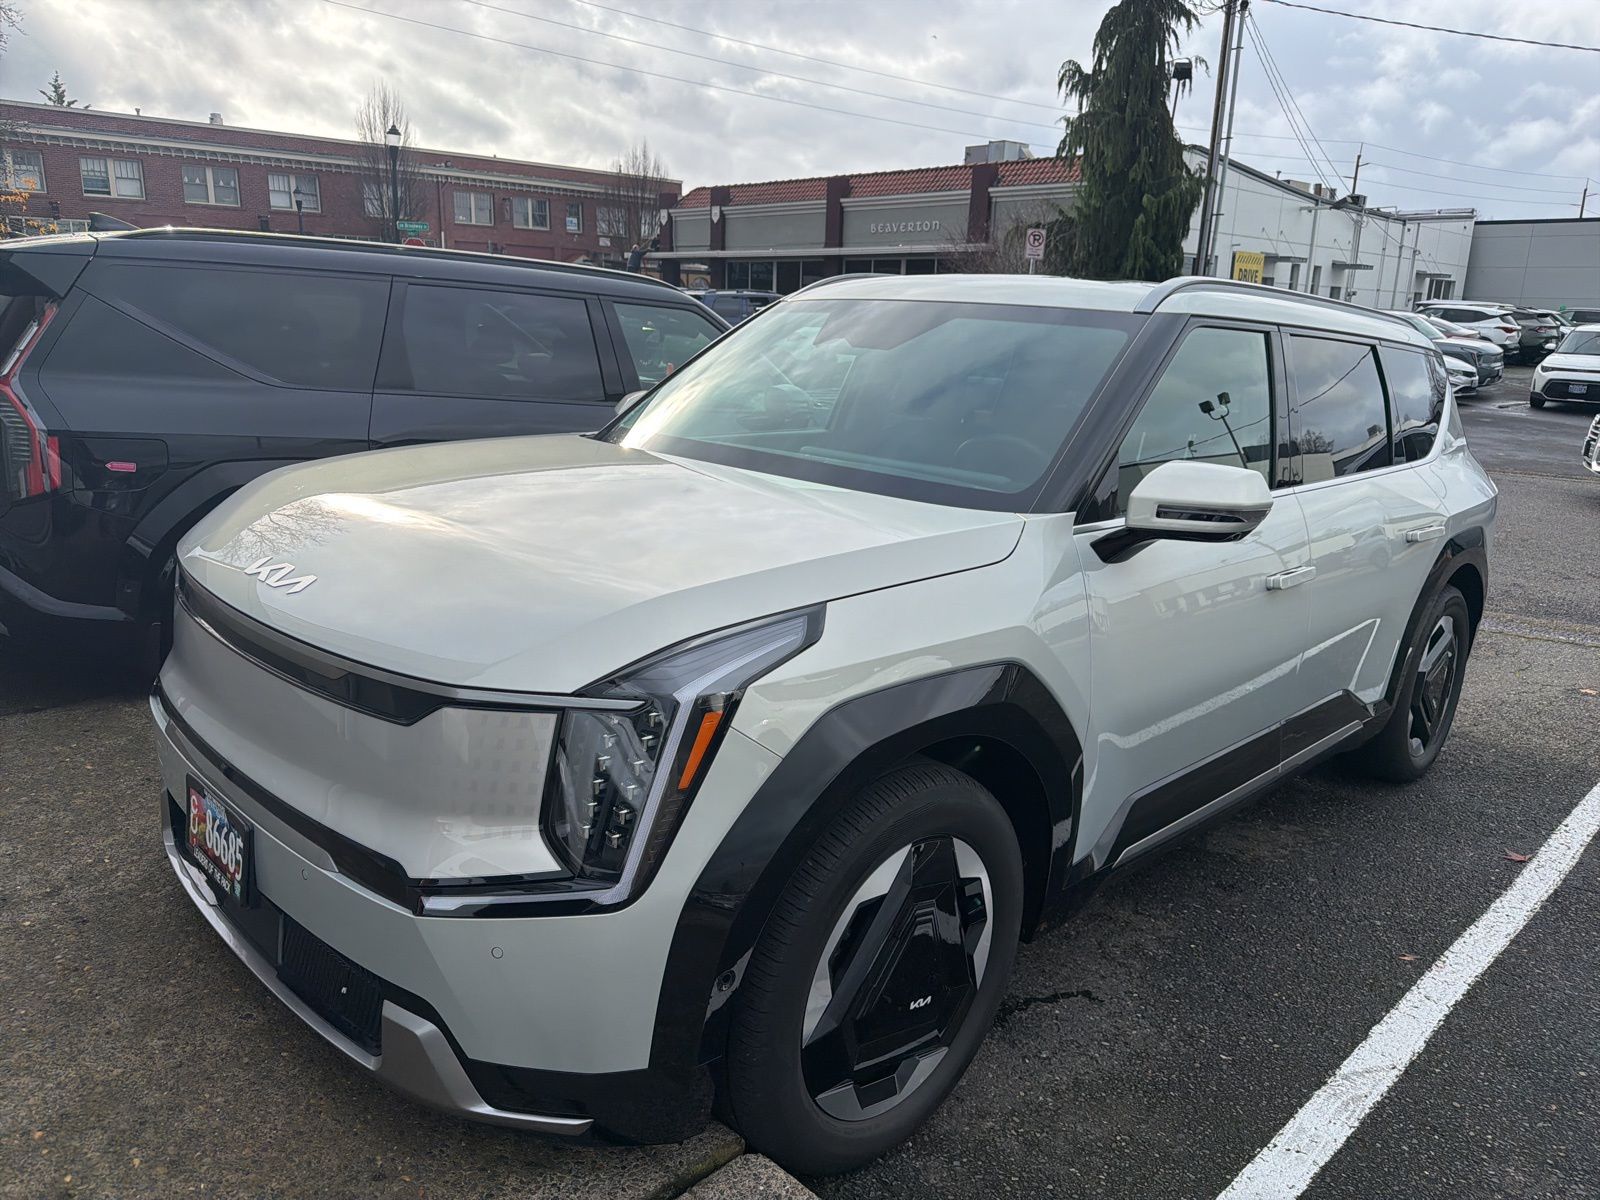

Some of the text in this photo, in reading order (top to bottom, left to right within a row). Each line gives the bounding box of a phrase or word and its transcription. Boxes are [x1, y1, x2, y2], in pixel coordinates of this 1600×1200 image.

[1238, 268, 1259, 283] DRIVE
[243, 556, 318, 595] KIA
[206, 810, 244, 881] 86685
[909, 995, 932, 1010] KIA
